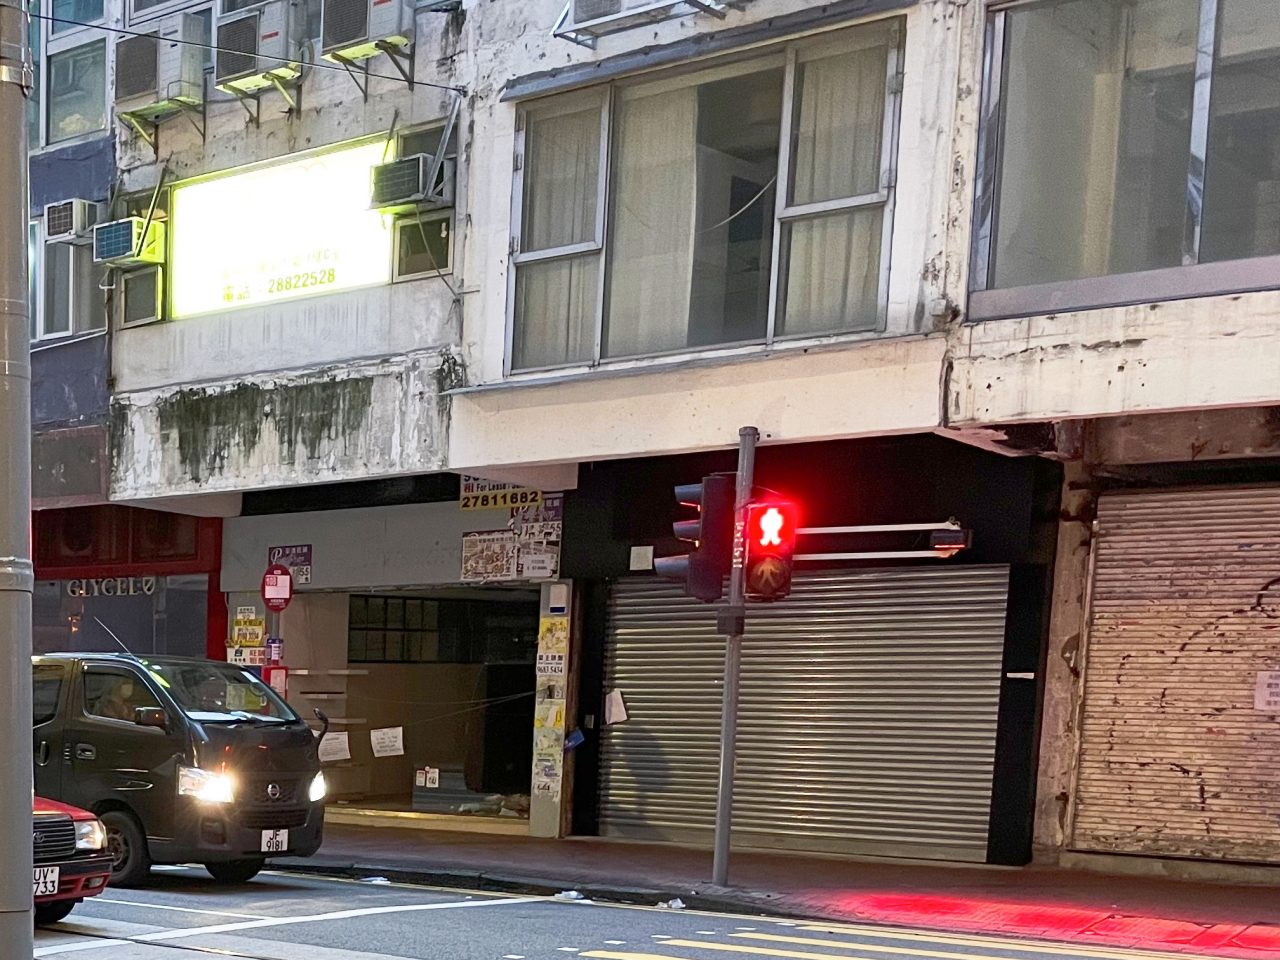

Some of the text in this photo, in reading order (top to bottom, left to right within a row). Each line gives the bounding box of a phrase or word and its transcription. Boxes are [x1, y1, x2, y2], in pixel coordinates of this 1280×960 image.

[268, 268, 335, 293] 28822528
[462, 490, 538, 508] 27811682
[67, 577, 143, 597] GLYCEL
[266, 840, 284, 852] 9181
[33, 868, 50, 882] UV
